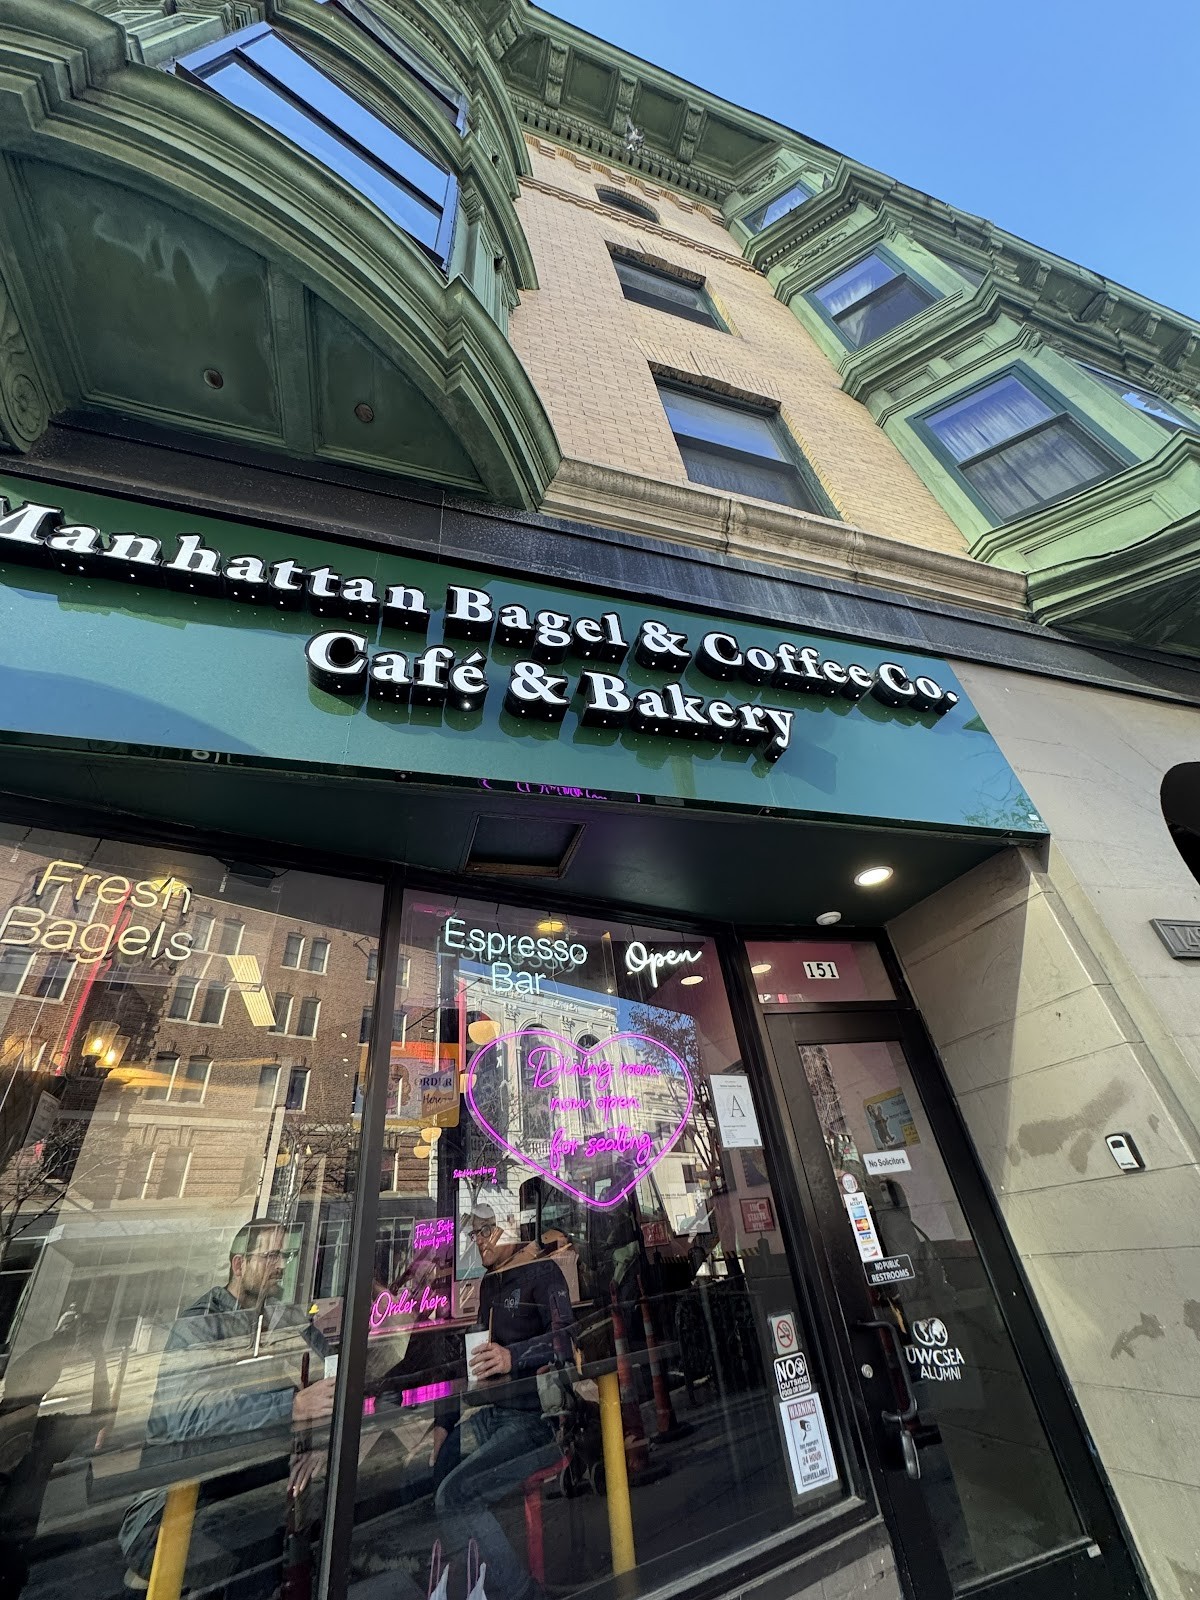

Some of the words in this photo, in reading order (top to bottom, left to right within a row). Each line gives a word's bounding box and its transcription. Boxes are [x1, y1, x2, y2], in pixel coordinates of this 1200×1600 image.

[0, 496, 430, 614] Manhattan
[447, 584, 629, 648] Bagel
[641, 619, 693, 658] &
[702, 631, 873, 688] Coffee
[877, 661, 960, 703] Co.
[304, 629, 488, 694] Café
[509, 657, 571, 705] &
[581, 668, 796, 749] Bakery
[35, 859, 193, 915] Fresh
[0, 905, 195, 964] Bagels
[443, 916, 589, 966] Espresso
[1169, 925, 1200, 951] 14
[624, 939, 703, 989] Open
[806, 962, 837, 978] 151
[490, 960, 548, 996] Bar
[527, 1045, 614, 1092] Dining
[620, 1060, 662, 1077] room
[550, 1096, 592, 1112] now
[595, 1094, 641, 1124] open
[730, 1094, 747, 1118] A
[549, 1126, 580, 1172] for
[584, 1120, 655, 1166] seating
[868, 1160, 878, 1168] No
[878, 1156, 907, 1168] Solicitors
[870, 1267, 911, 1283] RESTROOMS
[874, 1262, 884, 1271] NO
[883, 1258, 901, 1270] PUBLIC
[370, 1288, 418, 1328] Order
[419, 1285, 449, 1313] here
[904, 1345, 966, 1367] UWCSEA
[776, 1359, 796, 1382] NO
[780, 1375, 809, 1390] OUTSIDE
[920, 1364, 963, 1382] ALUMNI
[781, 1387, 793, 1397] FOOD
[788, 1400, 816, 1418] WARNING
[808, 1450, 822, 1464] HOUR
[802, 1467, 829, 1483] SURVEILLANCE
